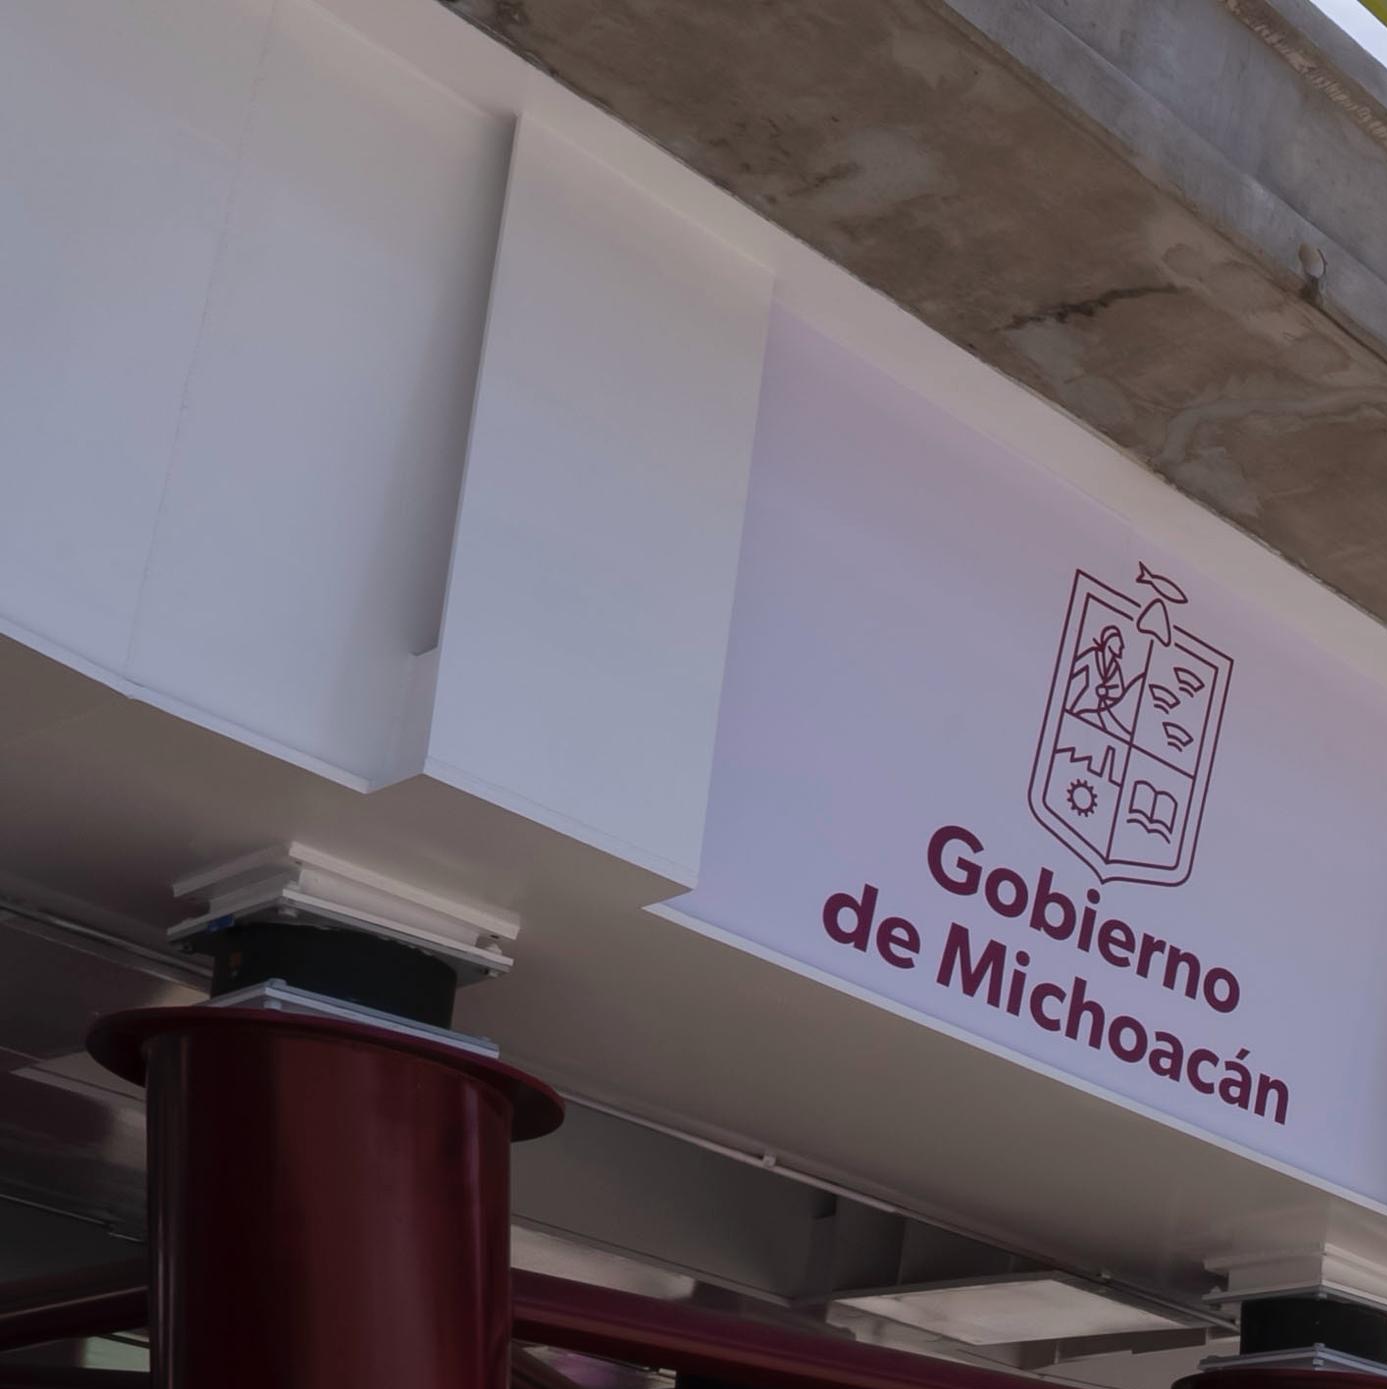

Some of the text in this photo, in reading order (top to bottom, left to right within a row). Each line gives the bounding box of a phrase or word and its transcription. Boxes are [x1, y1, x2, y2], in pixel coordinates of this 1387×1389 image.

[822, 884, 1289, 1125] de Michoacán
[926, 825, 1240, 1013] Gobierno
